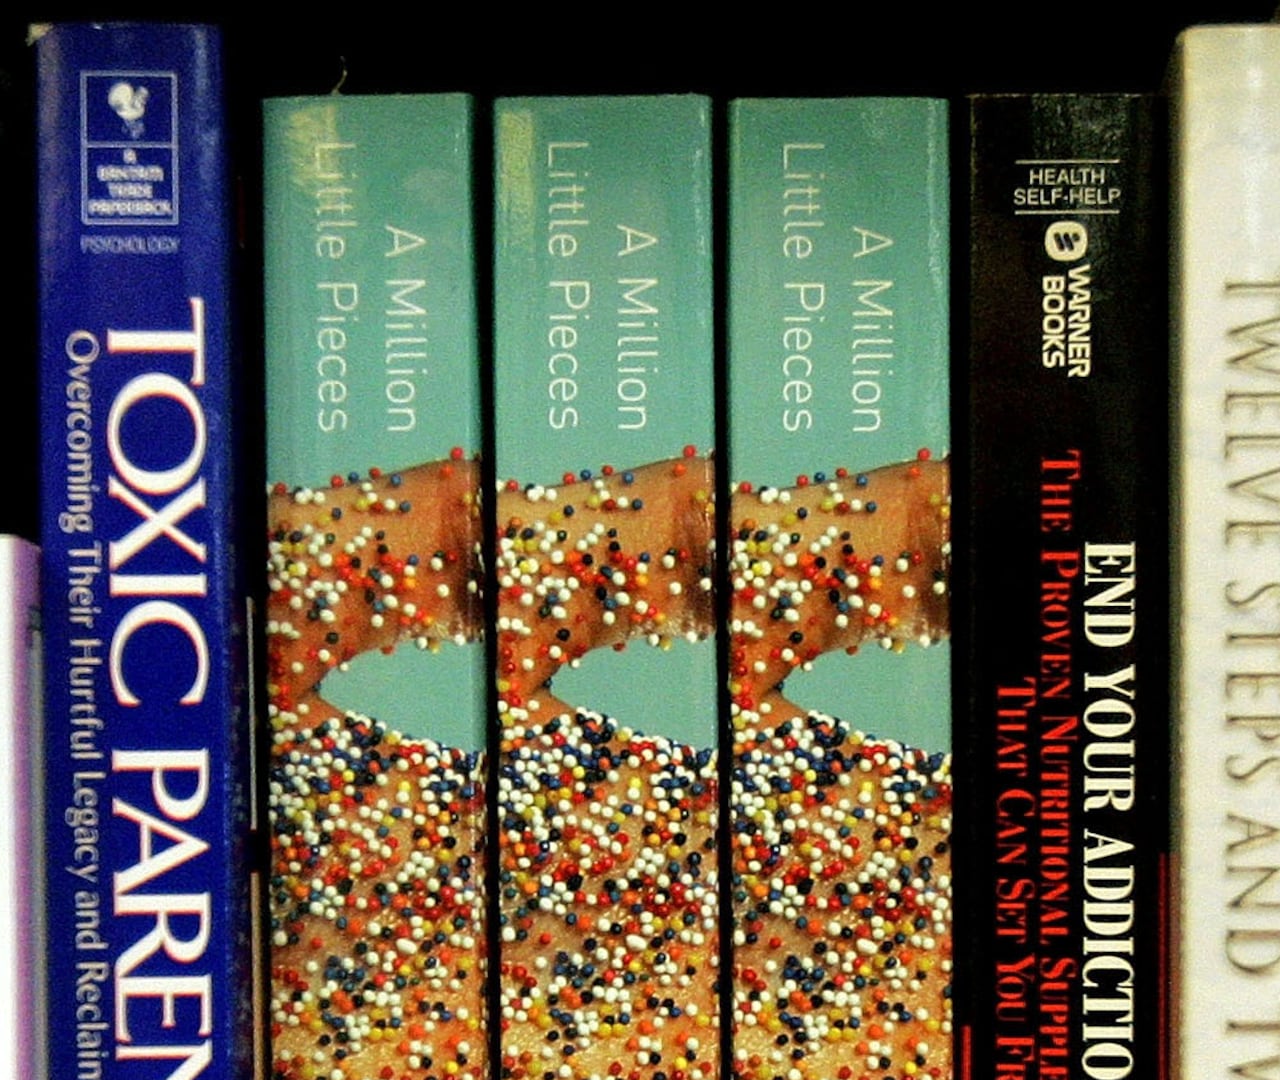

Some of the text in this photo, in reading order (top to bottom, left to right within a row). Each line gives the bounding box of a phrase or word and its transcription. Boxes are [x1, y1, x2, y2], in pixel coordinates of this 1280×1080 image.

[1013, 187, 1122, 206] SELF-HELP
[1028, 167, 1106, 186] HEALTH
[315, 142, 359, 433] Little Pieces
[385, 224, 429, 433] A Million
[547, 142, 591, 431] Little Pieces
[617, 224, 660, 431] A Million
[782, 142, 826, 433] Little Pieces
[851, 225, 894, 433] A Million
[1042, 274, 1067, 369] BOOKS
[1066, 264, 1092, 379] WARNER
[59, 330, 100, 532] Overcoming
[106, 297, 212, 707] TOXIC
[69, 540, 102, 629] Their
[1083, 541, 1136, 648] END
[69, 640, 105, 760] Hurtful
[1082, 663, 1136, 813] YOUR
[65, 763, 107, 885] Legacy
[1038, 714, 1079, 947] NUTRITIONAL
[74, 890, 107, 951] and
